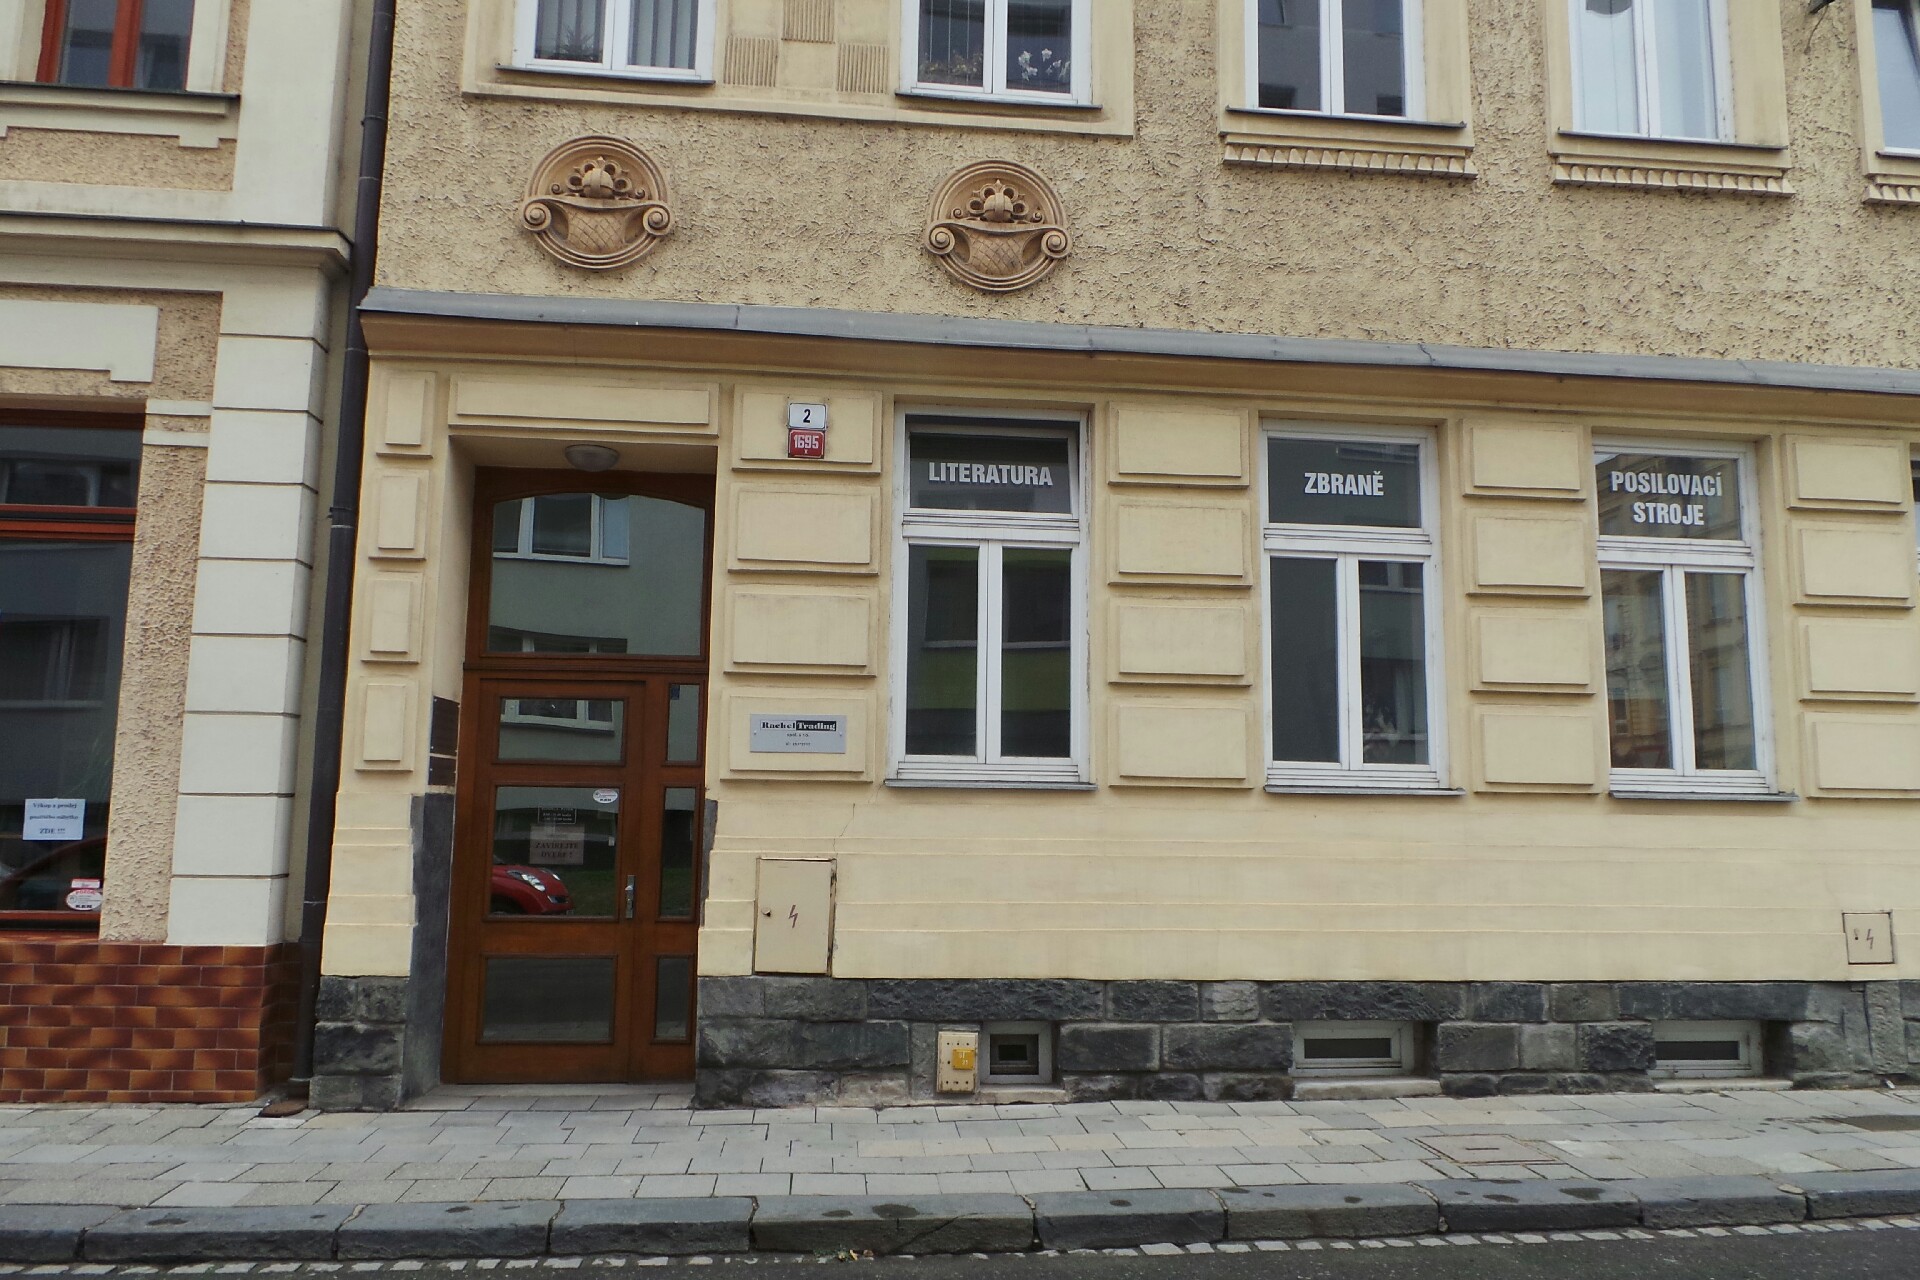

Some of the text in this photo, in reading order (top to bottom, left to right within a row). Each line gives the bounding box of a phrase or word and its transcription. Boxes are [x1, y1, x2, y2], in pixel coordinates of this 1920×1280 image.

[803, 409, 811, 423] 2
[794, 434, 819, 448] 1695
[928, 462, 1053, 486] LITERATURA
[1304, 471, 1384, 496] ZBRANĚ
[1611, 471, 1722, 497] POSILOVACÍ
[1633, 502, 1704, 526] STROJE
[796, 722, 836, 731] Trading
